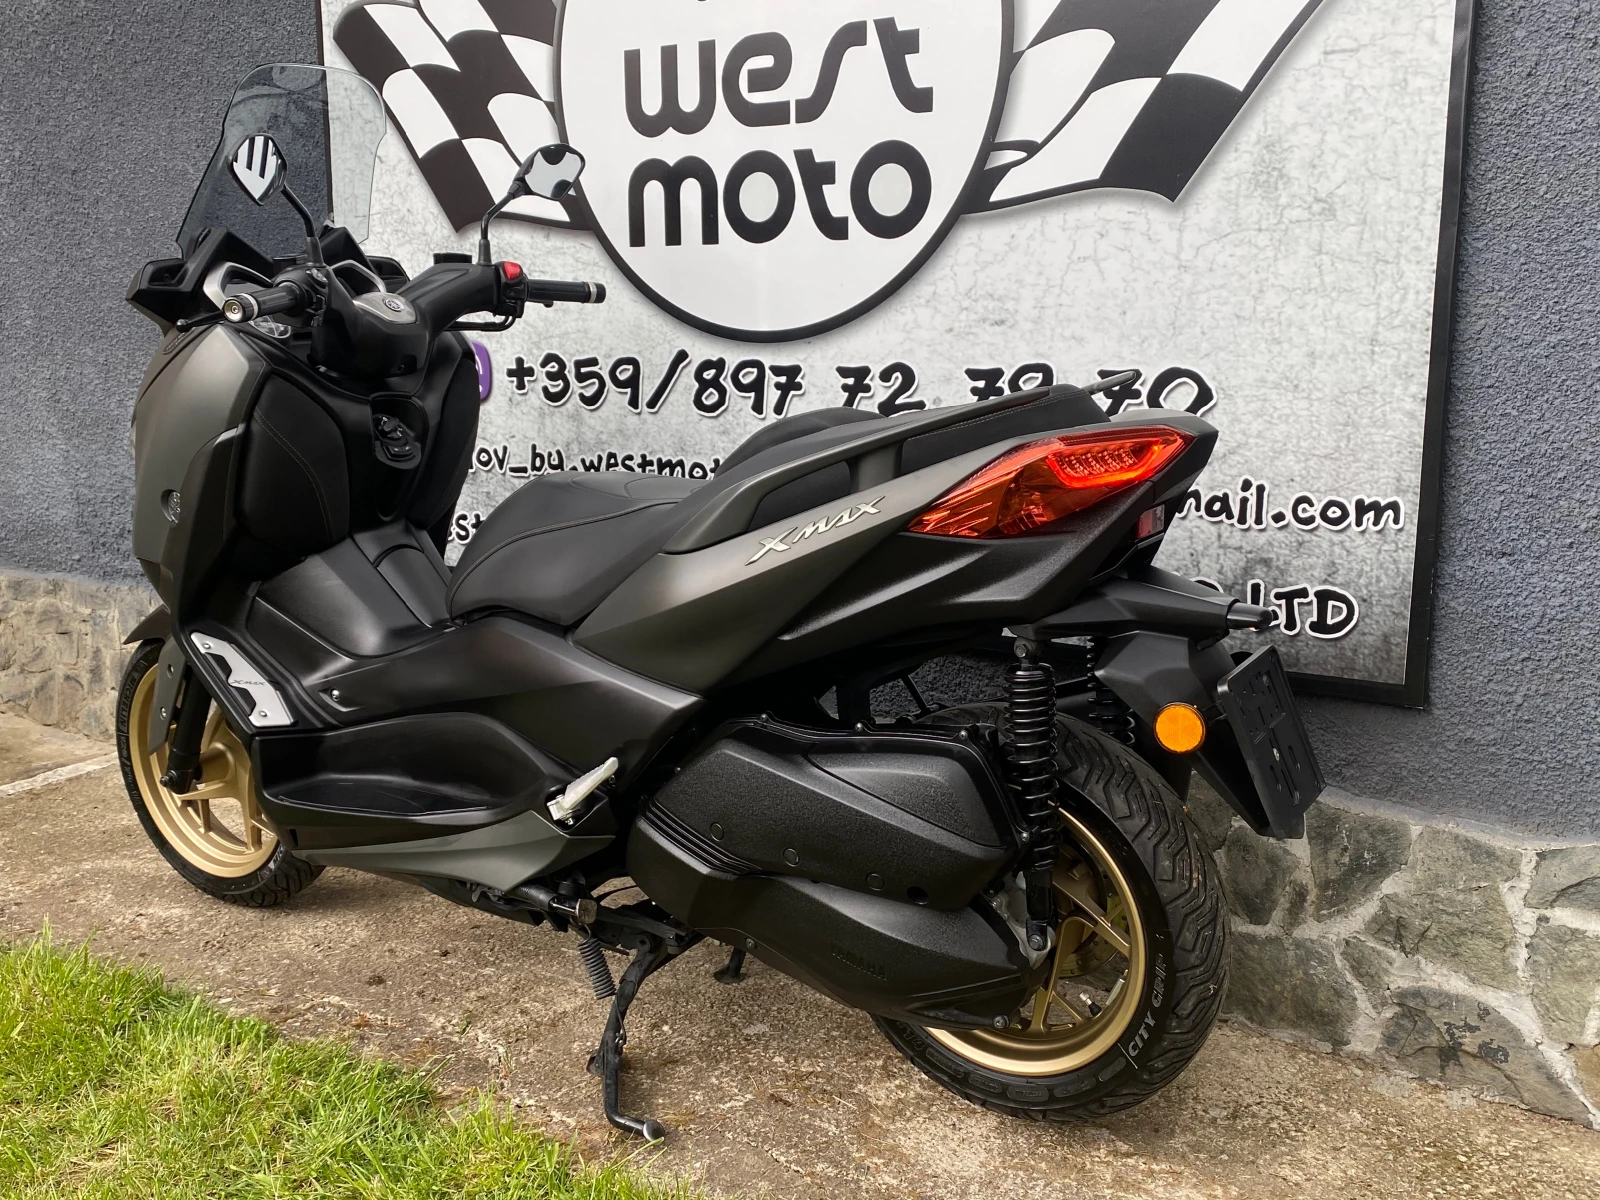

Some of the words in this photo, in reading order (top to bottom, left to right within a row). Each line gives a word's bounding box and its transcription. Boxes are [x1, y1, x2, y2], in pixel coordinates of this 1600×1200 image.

[624, 17, 933, 137] west
[629, 140, 932, 248] moto
[506, 349, 803, 417] +359/897
[836, 362, 927, 417] 72
[1097, 366, 1214, 417] 70
[744, 496, 886, 566] XMAX
[1128, 1010, 1156, 1057] CITY
[1151, 953, 1167, 1008] GRIP
